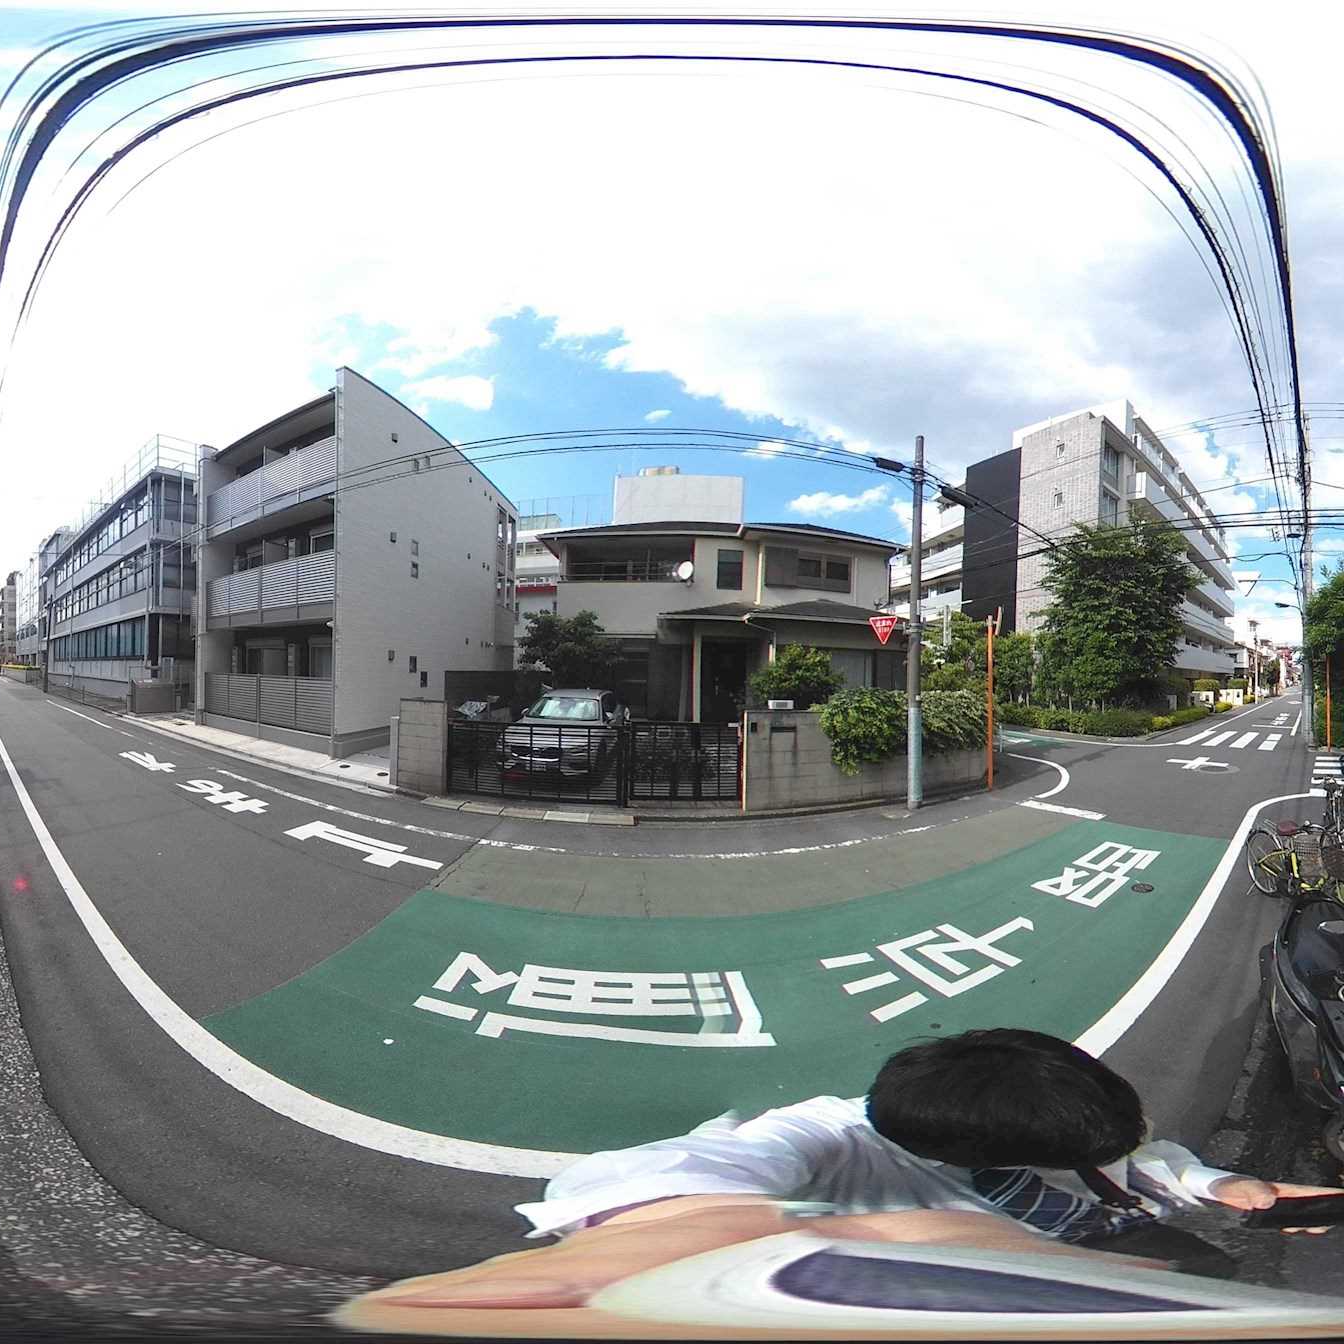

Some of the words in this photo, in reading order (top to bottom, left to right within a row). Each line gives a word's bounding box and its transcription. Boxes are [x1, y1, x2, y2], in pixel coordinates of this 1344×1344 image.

[118, 751, 444, 871] 止まれ
[413, 841, 1162, 1048] 通学路
